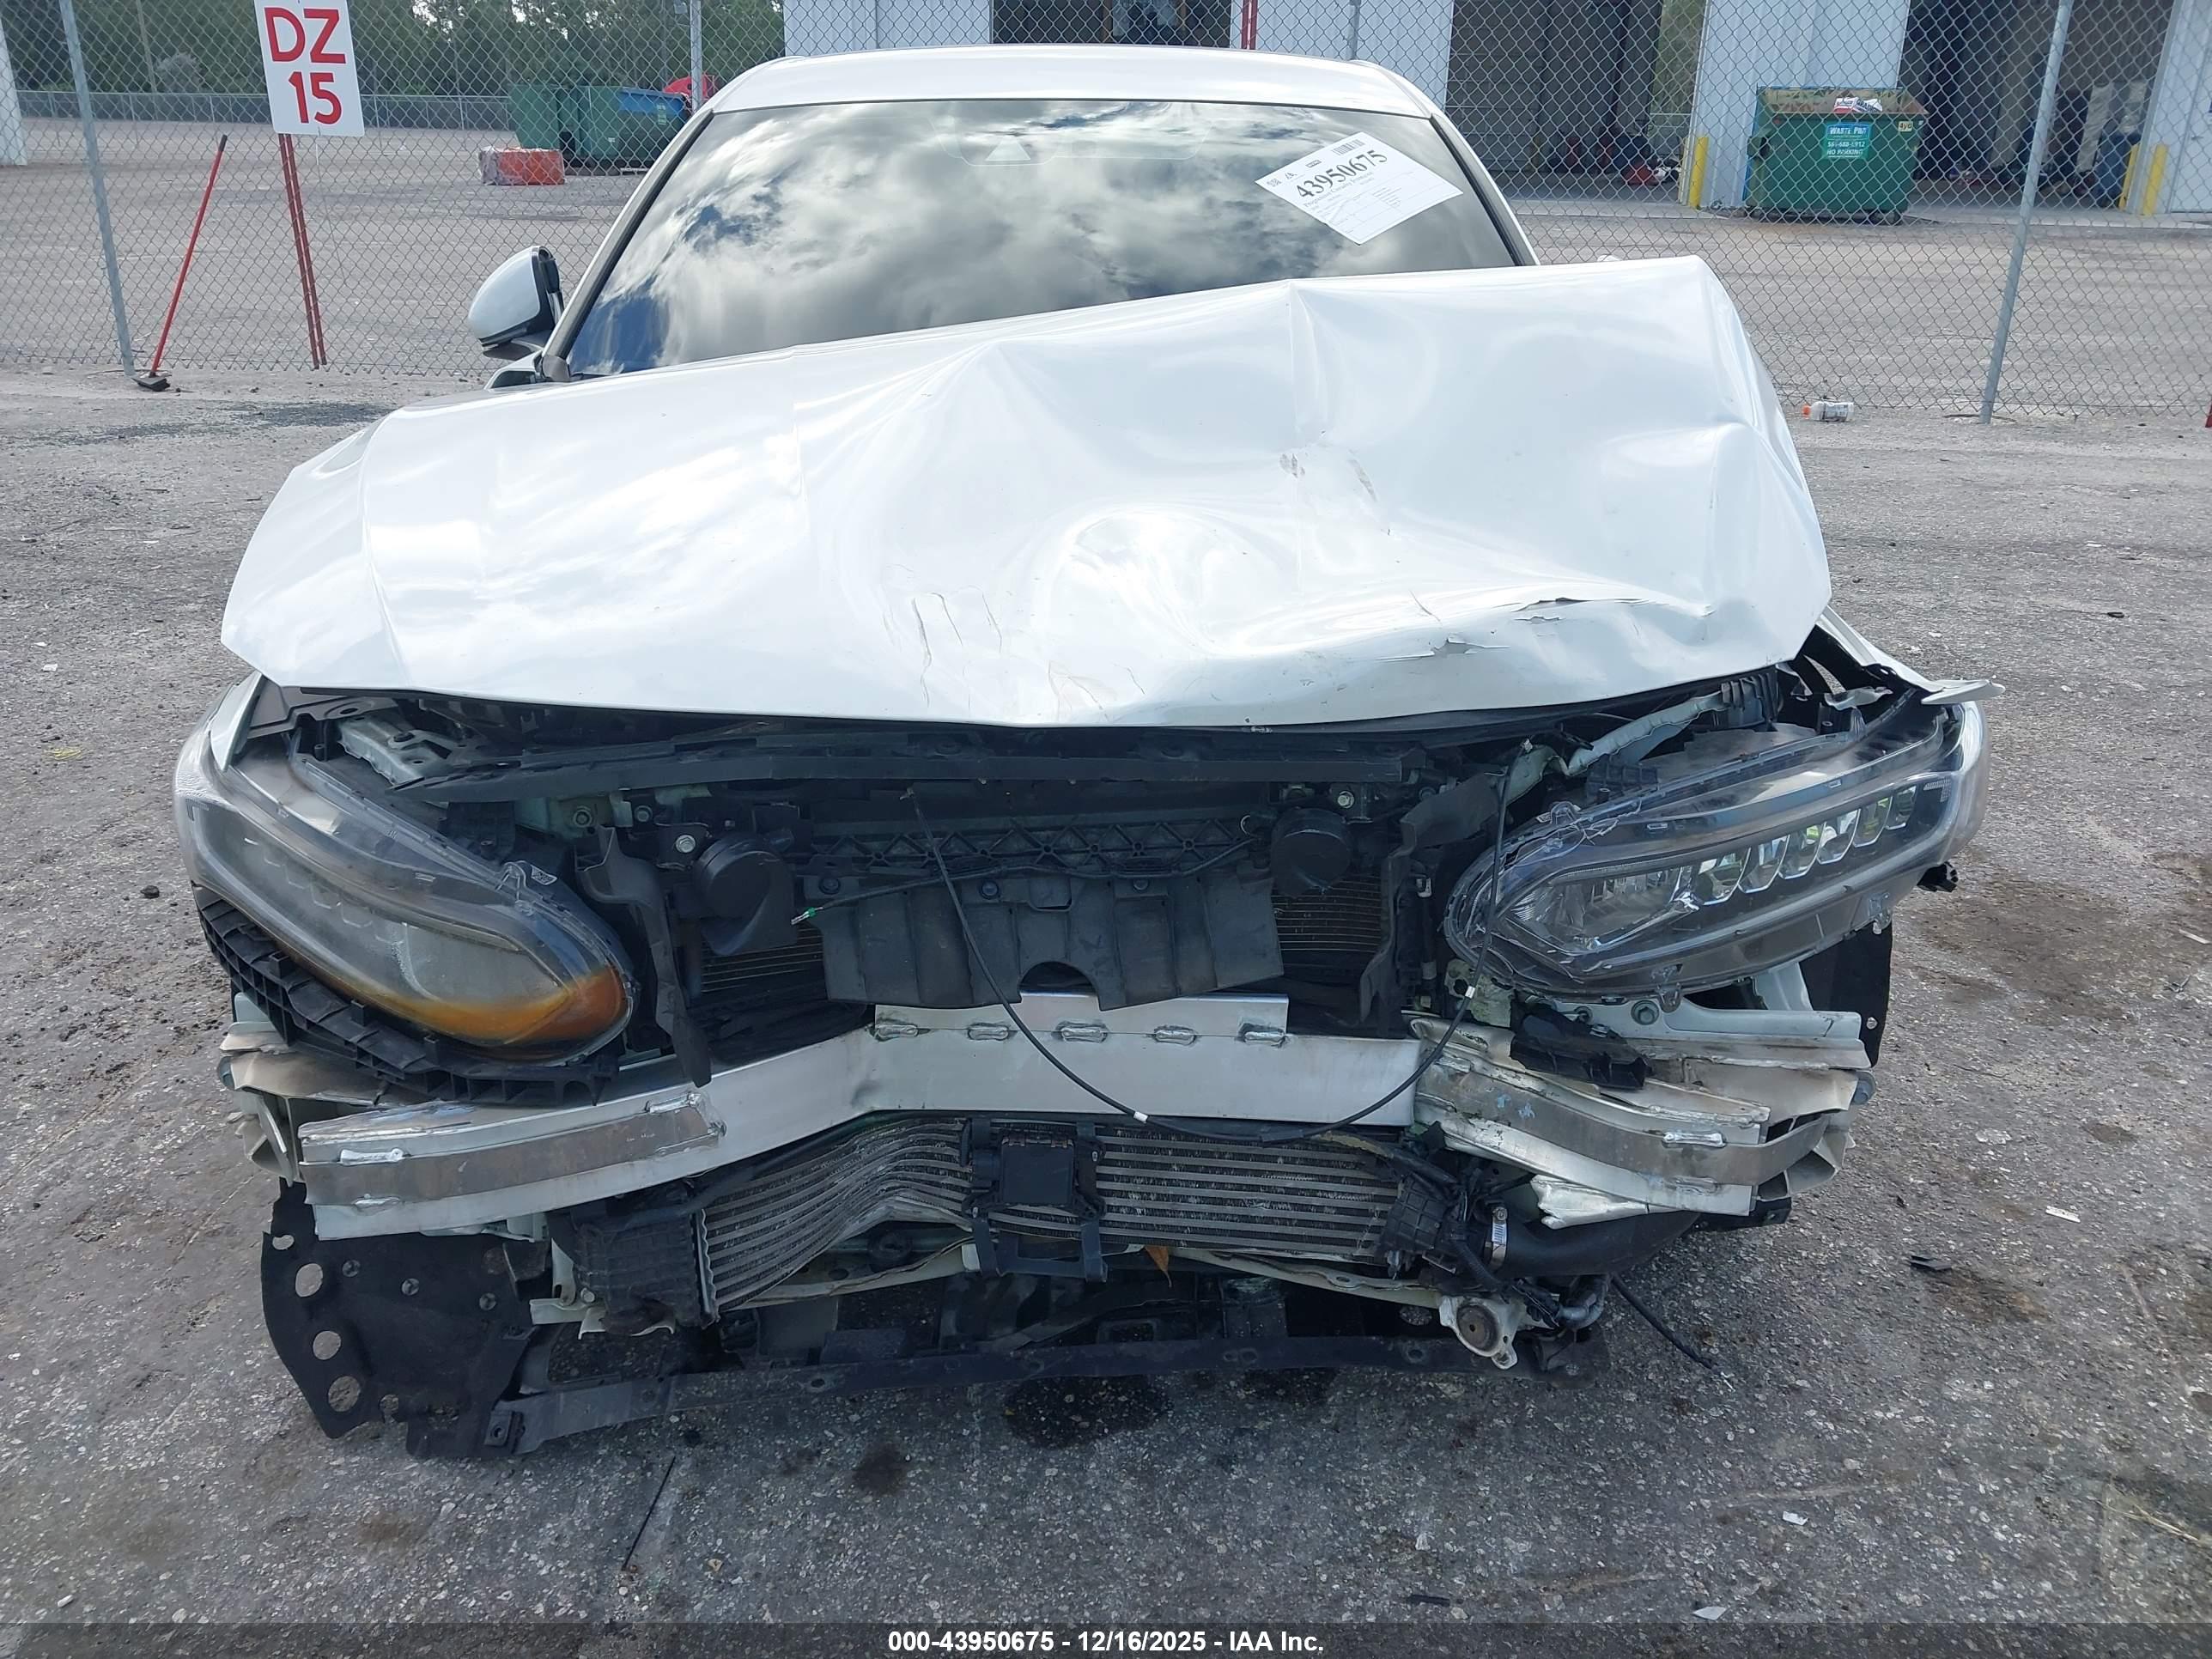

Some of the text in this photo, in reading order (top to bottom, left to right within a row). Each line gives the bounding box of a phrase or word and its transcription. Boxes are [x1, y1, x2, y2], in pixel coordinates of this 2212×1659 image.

[264, 7, 346, 64] DZ
[289, 71, 342, 125] 15
[1297, 149, 1388, 198] 43950675
